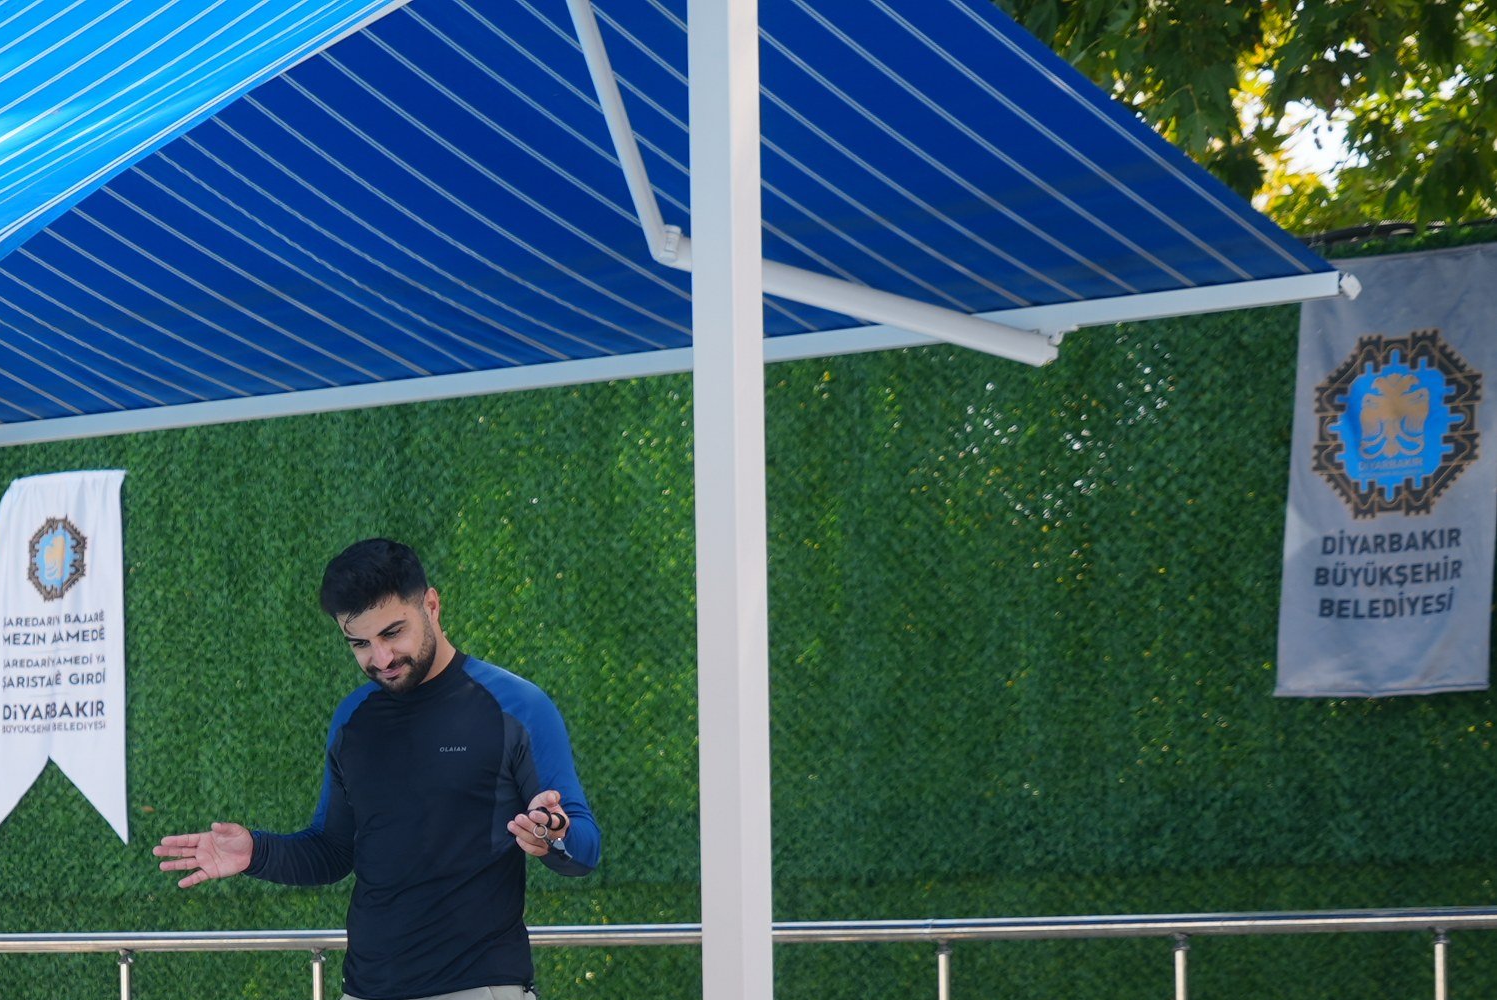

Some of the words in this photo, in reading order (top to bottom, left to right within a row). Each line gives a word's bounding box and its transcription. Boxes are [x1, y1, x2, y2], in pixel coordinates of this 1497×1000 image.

[1321, 528, 1462, 556] DİYARBAKIR
[1314, 555, 1463, 588] BÜYÜKŞEHİR
[1318, 586, 1455, 620] BELEDİYESİ
[3, 700, 105, 721] DİYARBAKIR
